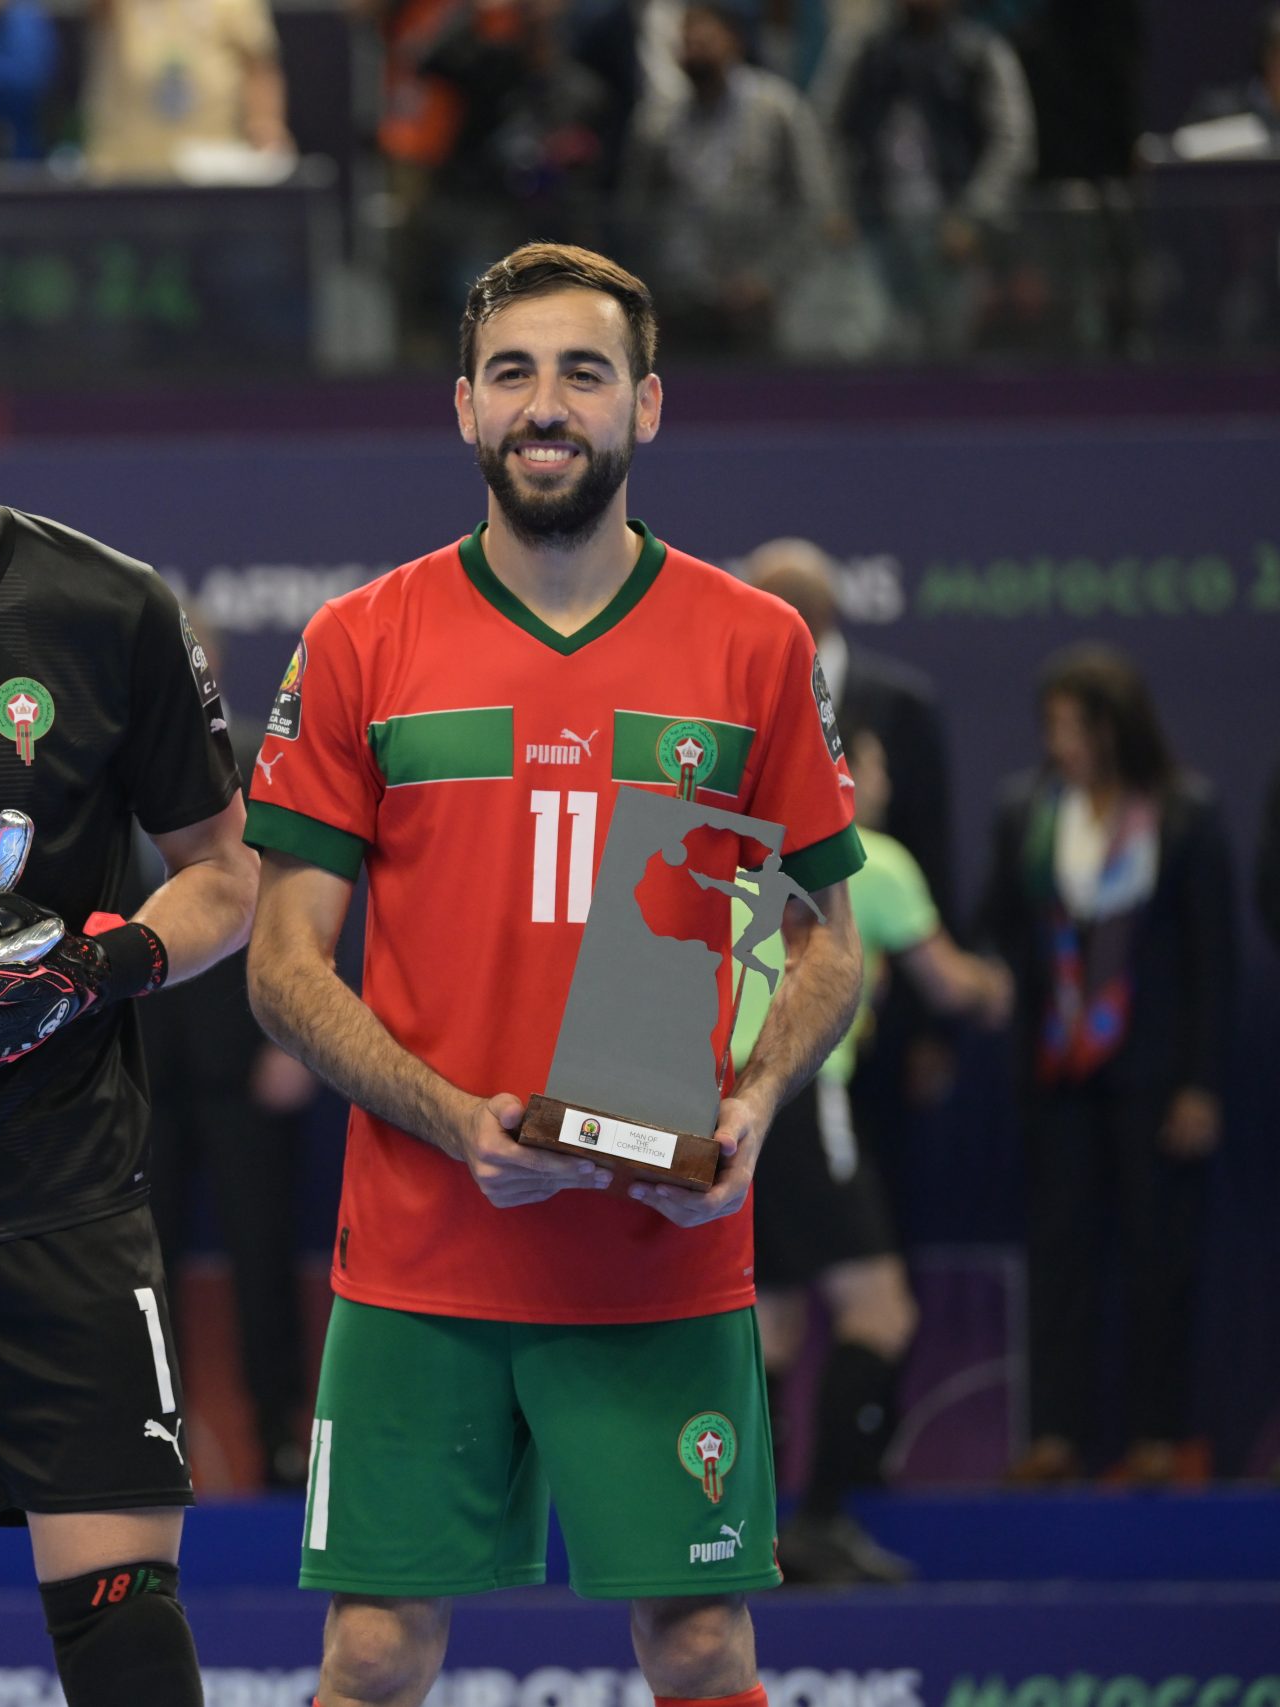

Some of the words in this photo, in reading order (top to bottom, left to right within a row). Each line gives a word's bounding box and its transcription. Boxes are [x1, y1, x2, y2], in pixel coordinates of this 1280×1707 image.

[279, 717, 293, 727] CUP
[526, 744, 581, 765] PUMA
[530, 790, 598, 923] 11
[629, 1131, 647, 1141] MAN
[647, 1135, 659, 1143] OF
[636, 1139, 650, 1148] THE
[616, 1141, 666, 1158] COMPETITION
[134, 1288, 176, 1414] 1
[689, 1539, 736, 1564] PUMA
